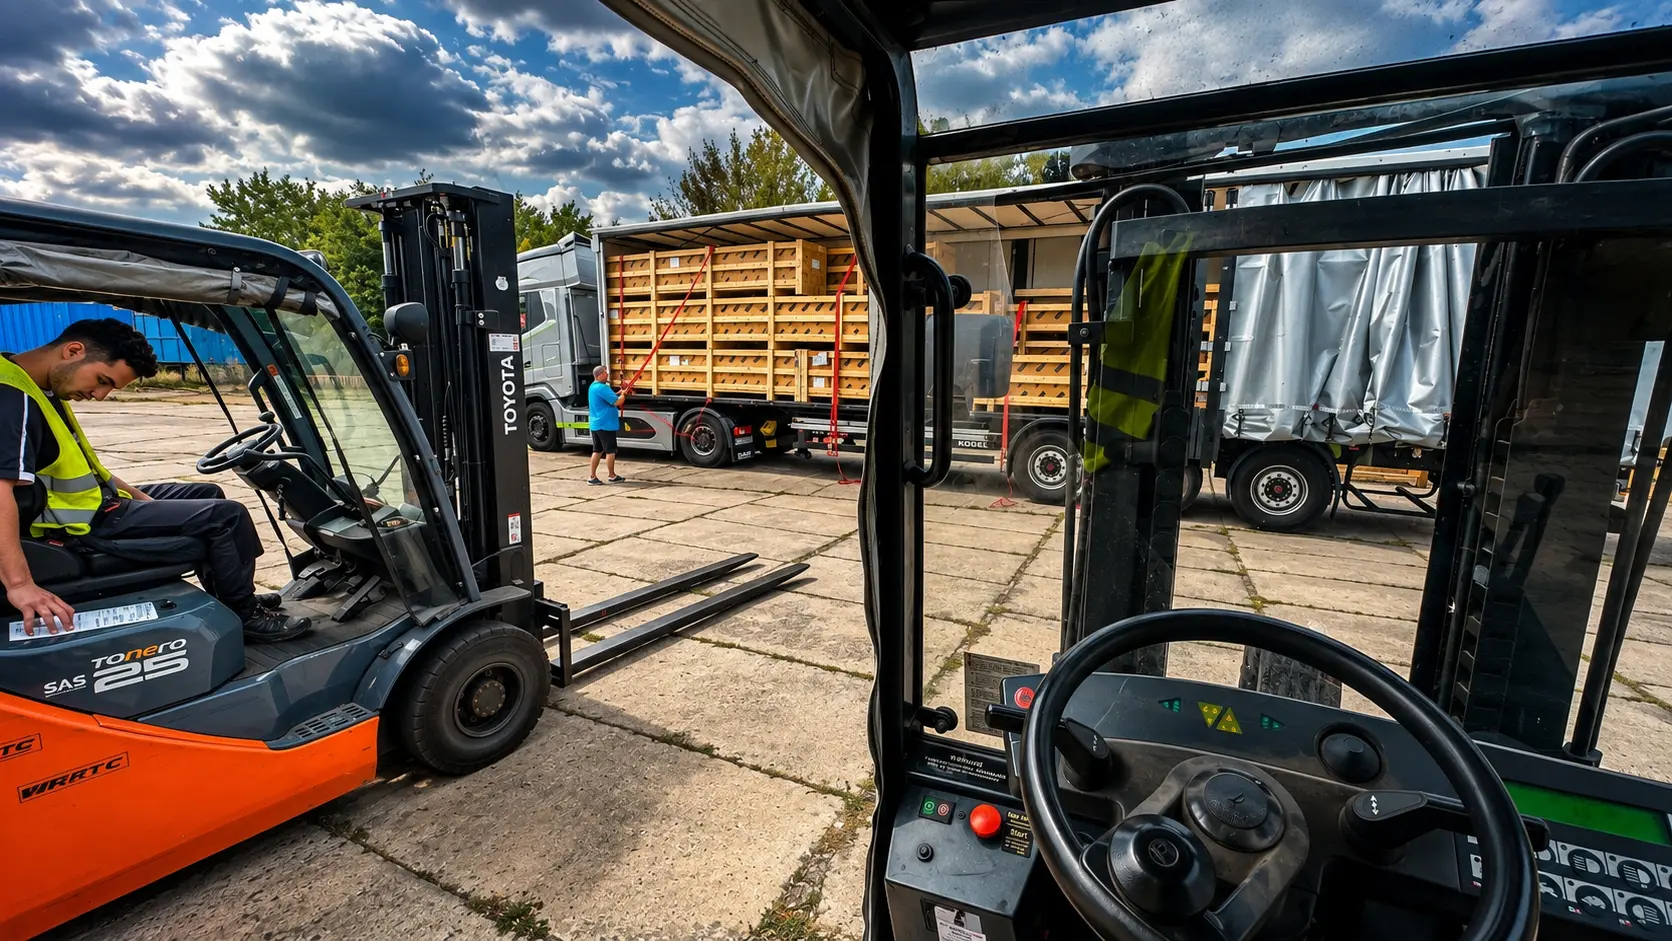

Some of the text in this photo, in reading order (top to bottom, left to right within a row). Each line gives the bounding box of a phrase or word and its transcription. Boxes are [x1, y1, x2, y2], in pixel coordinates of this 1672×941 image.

[500, 355, 518, 436] TOYOTA
[43, 674, 87, 695] SAS
[92, 649, 189, 694] 25
